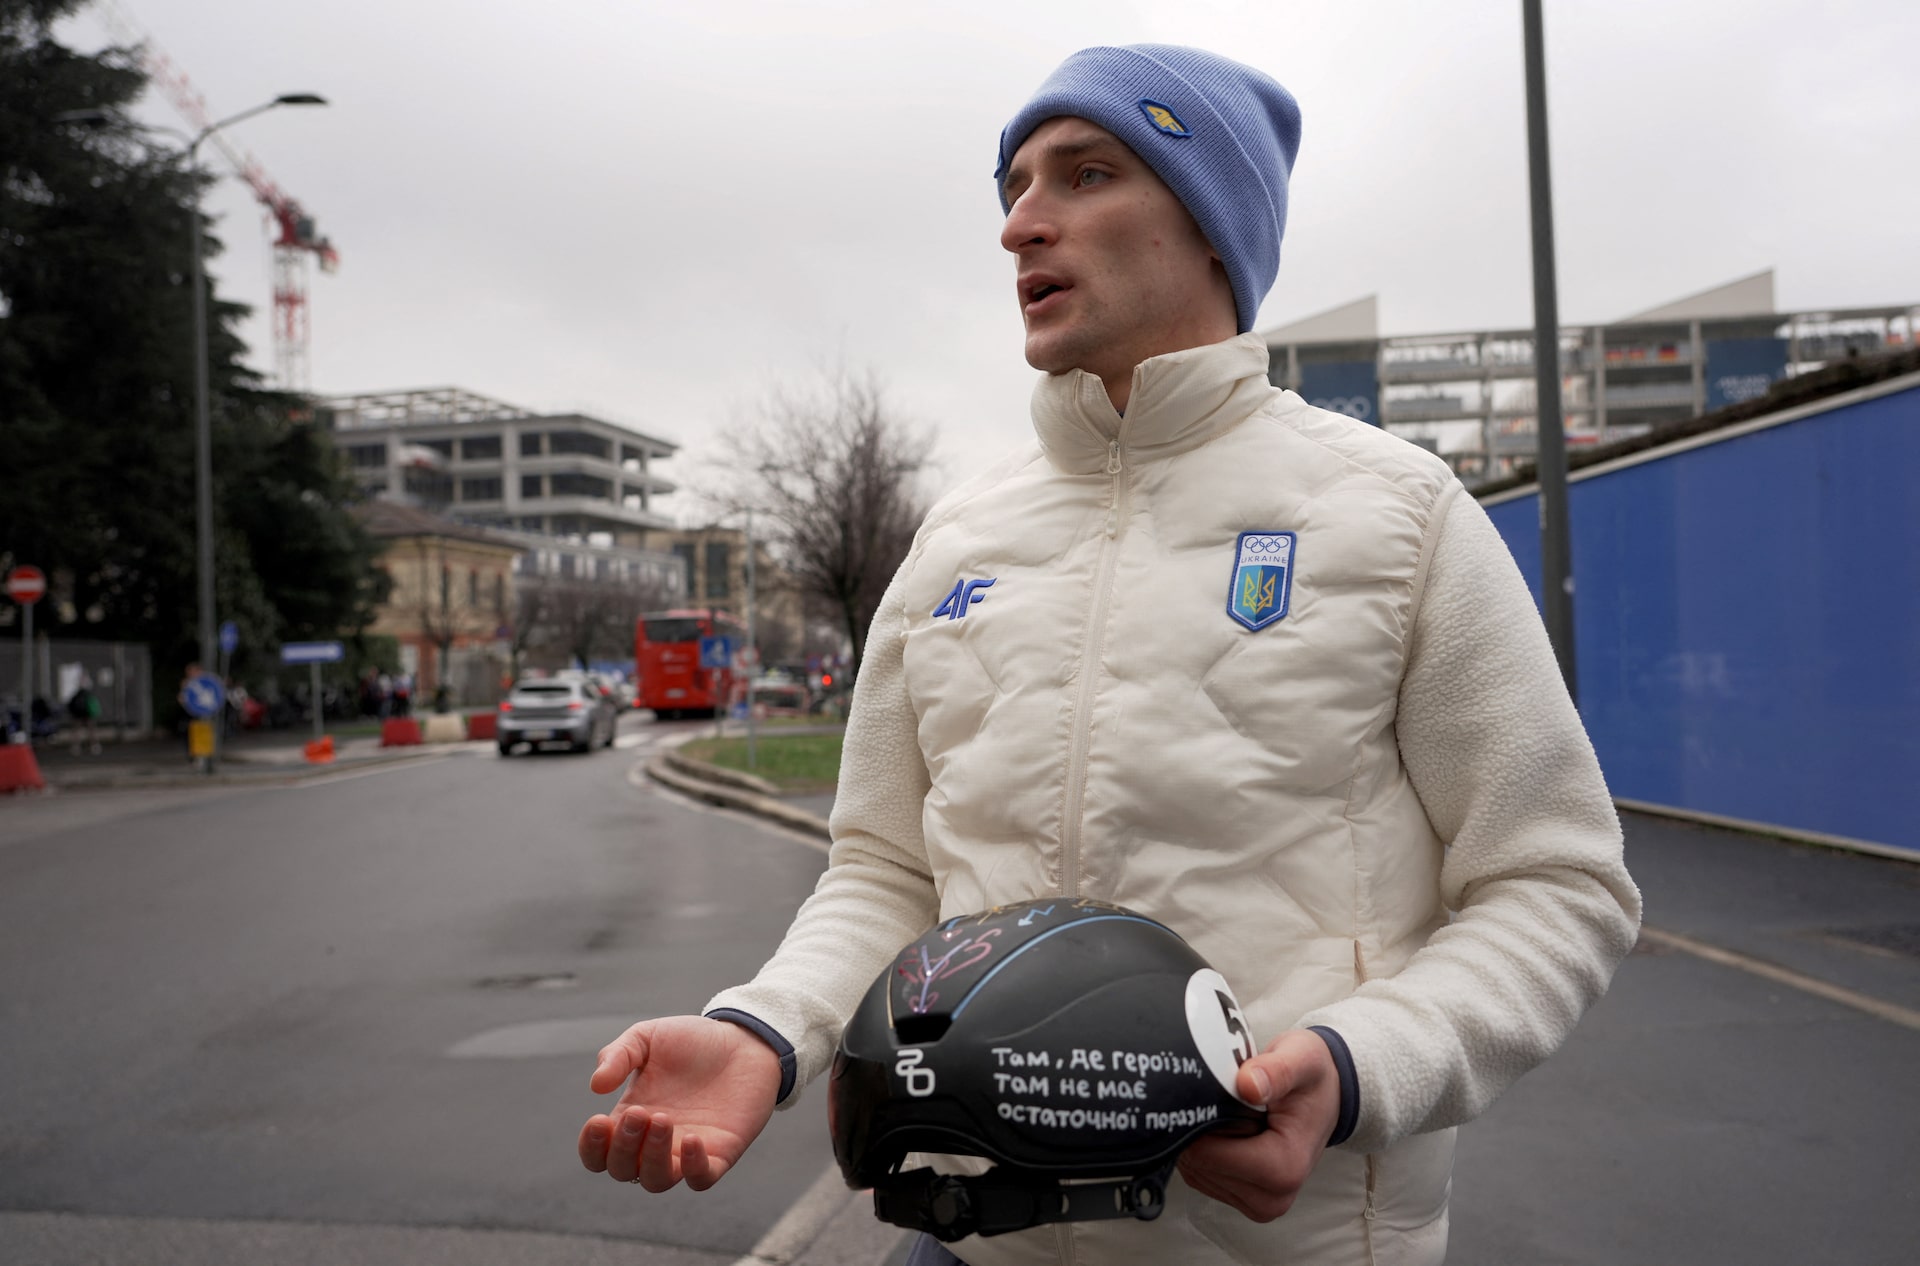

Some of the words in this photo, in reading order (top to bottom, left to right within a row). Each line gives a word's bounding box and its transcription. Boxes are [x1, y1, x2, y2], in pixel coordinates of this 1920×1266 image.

[1240, 555, 1287, 564] UKRAINE
[1112, 1050, 1202, 1078] героїзм,
[1060, 1078, 1091, 1098] не
[1097, 1080, 1147, 1099] має
[997, 1102, 1140, 1130] остаточної
[1145, 1104, 1217, 1132] поразки
